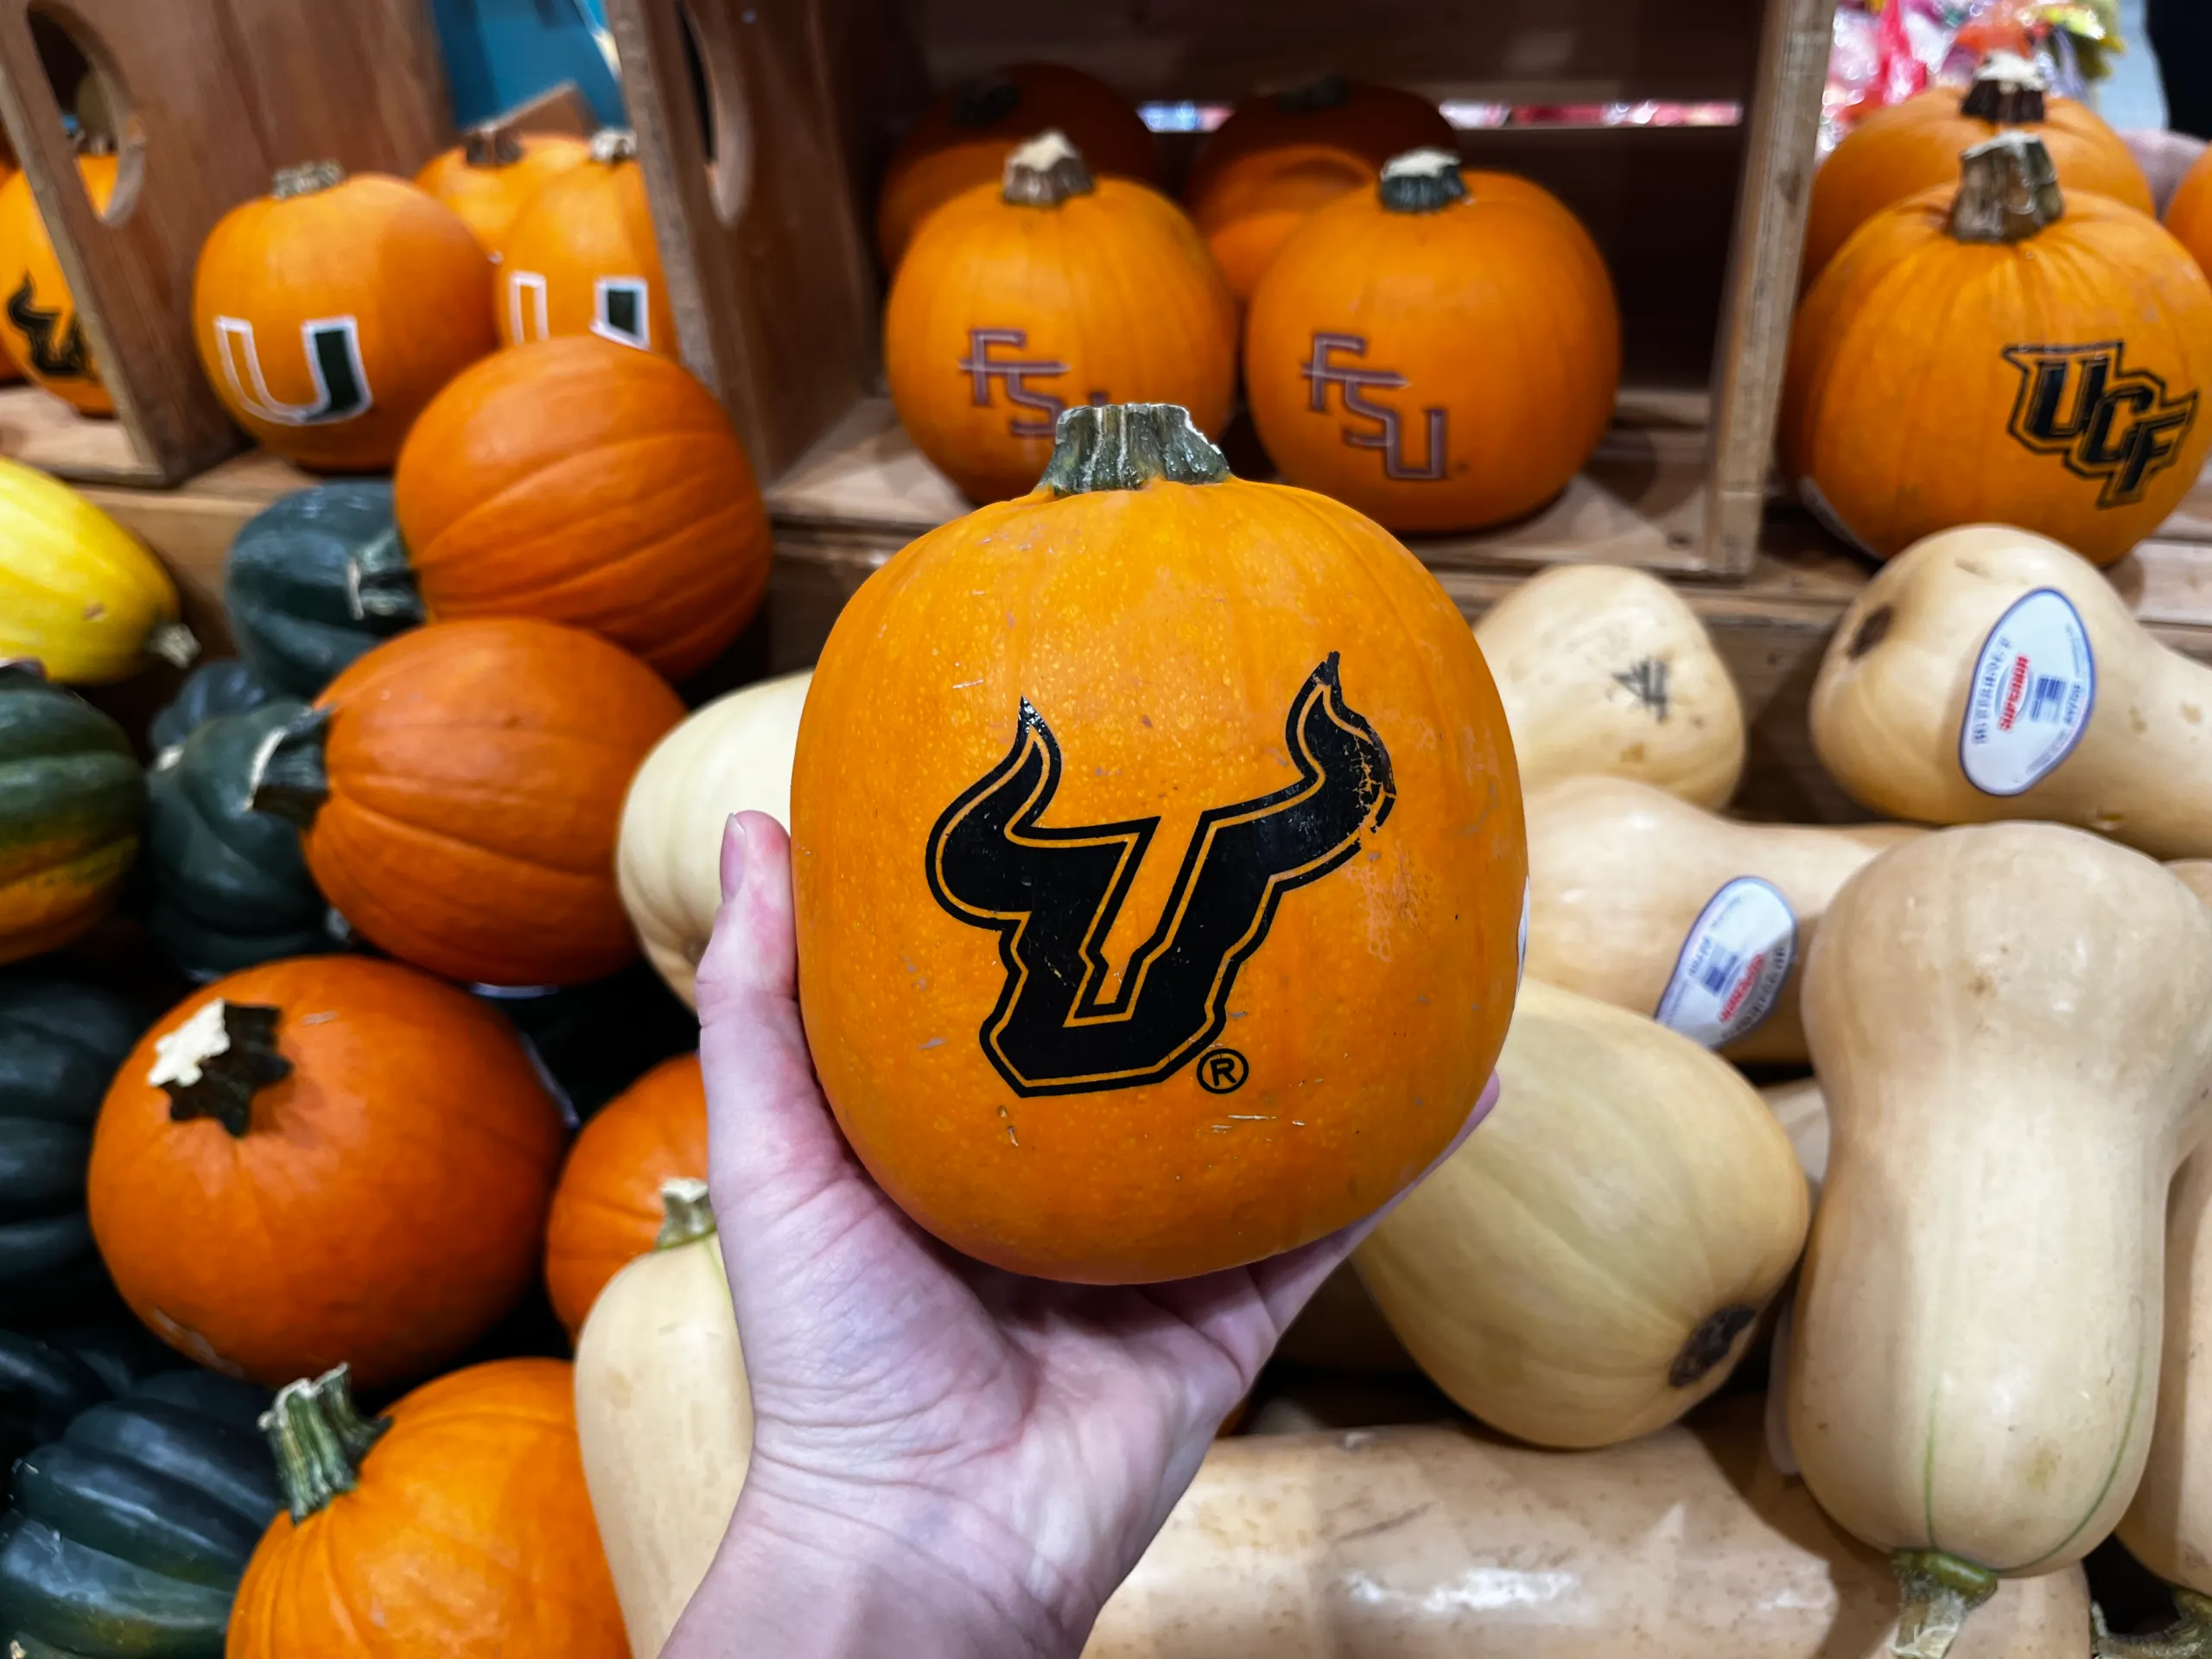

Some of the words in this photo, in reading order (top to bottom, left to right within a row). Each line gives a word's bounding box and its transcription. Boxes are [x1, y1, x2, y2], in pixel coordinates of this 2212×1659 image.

[213, 314, 374, 426] U
[959, 327, 1110, 437] FS
[1300, 331, 1450, 480] FSU
[2001, 340, 2199, 510] UCF
